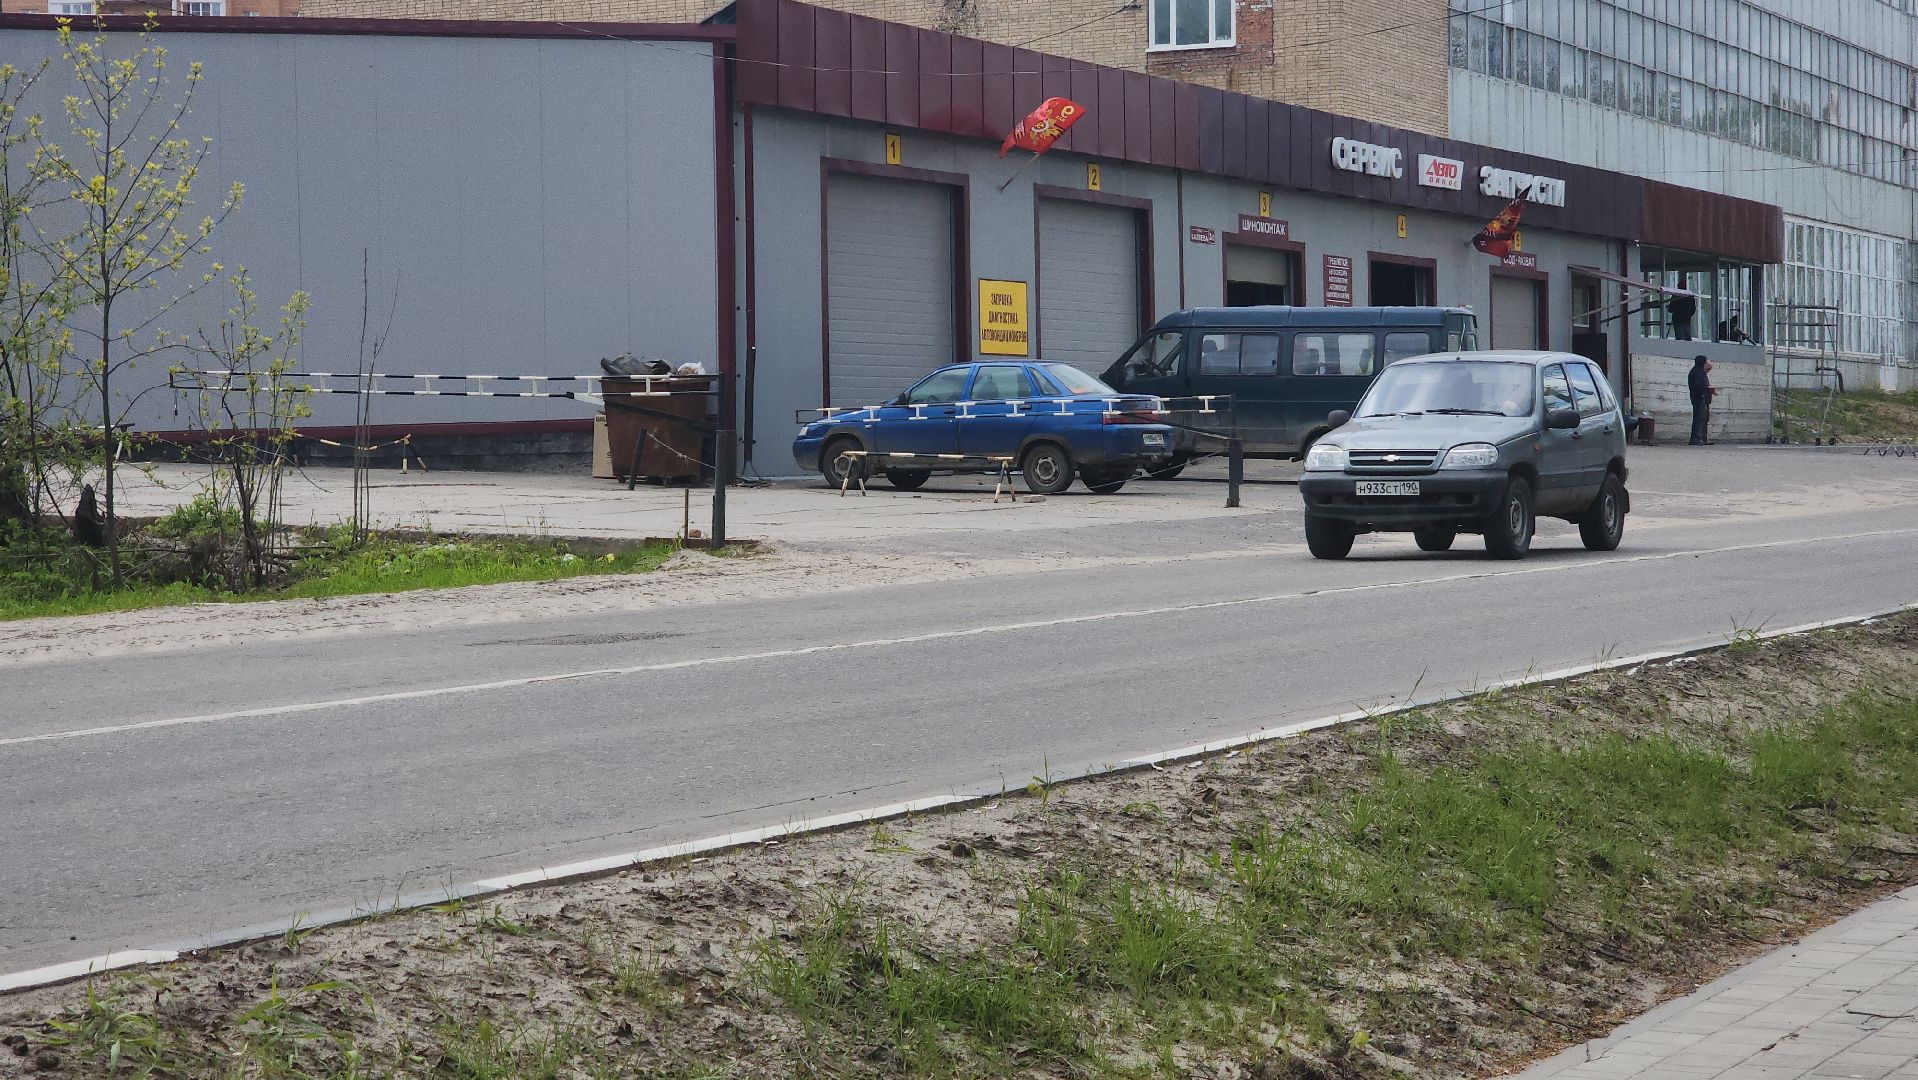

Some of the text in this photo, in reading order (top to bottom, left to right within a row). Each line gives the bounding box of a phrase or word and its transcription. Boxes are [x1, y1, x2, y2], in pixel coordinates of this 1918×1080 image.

[890, 140, 896, 159] 1
[1331, 136, 1403, 179] СЕРВИС
[1091, 168, 1098, 187] 2
[1425, 158, 1458, 179] АВТО
[1479, 165, 1566, 208] ЗАПЧАСТИ
[1262, 197, 1267, 213] 3
[1242, 218, 1286, 236] ШИНОМОНТАЖ
[1359, 482, 1417, 494] Н933СТ 190
